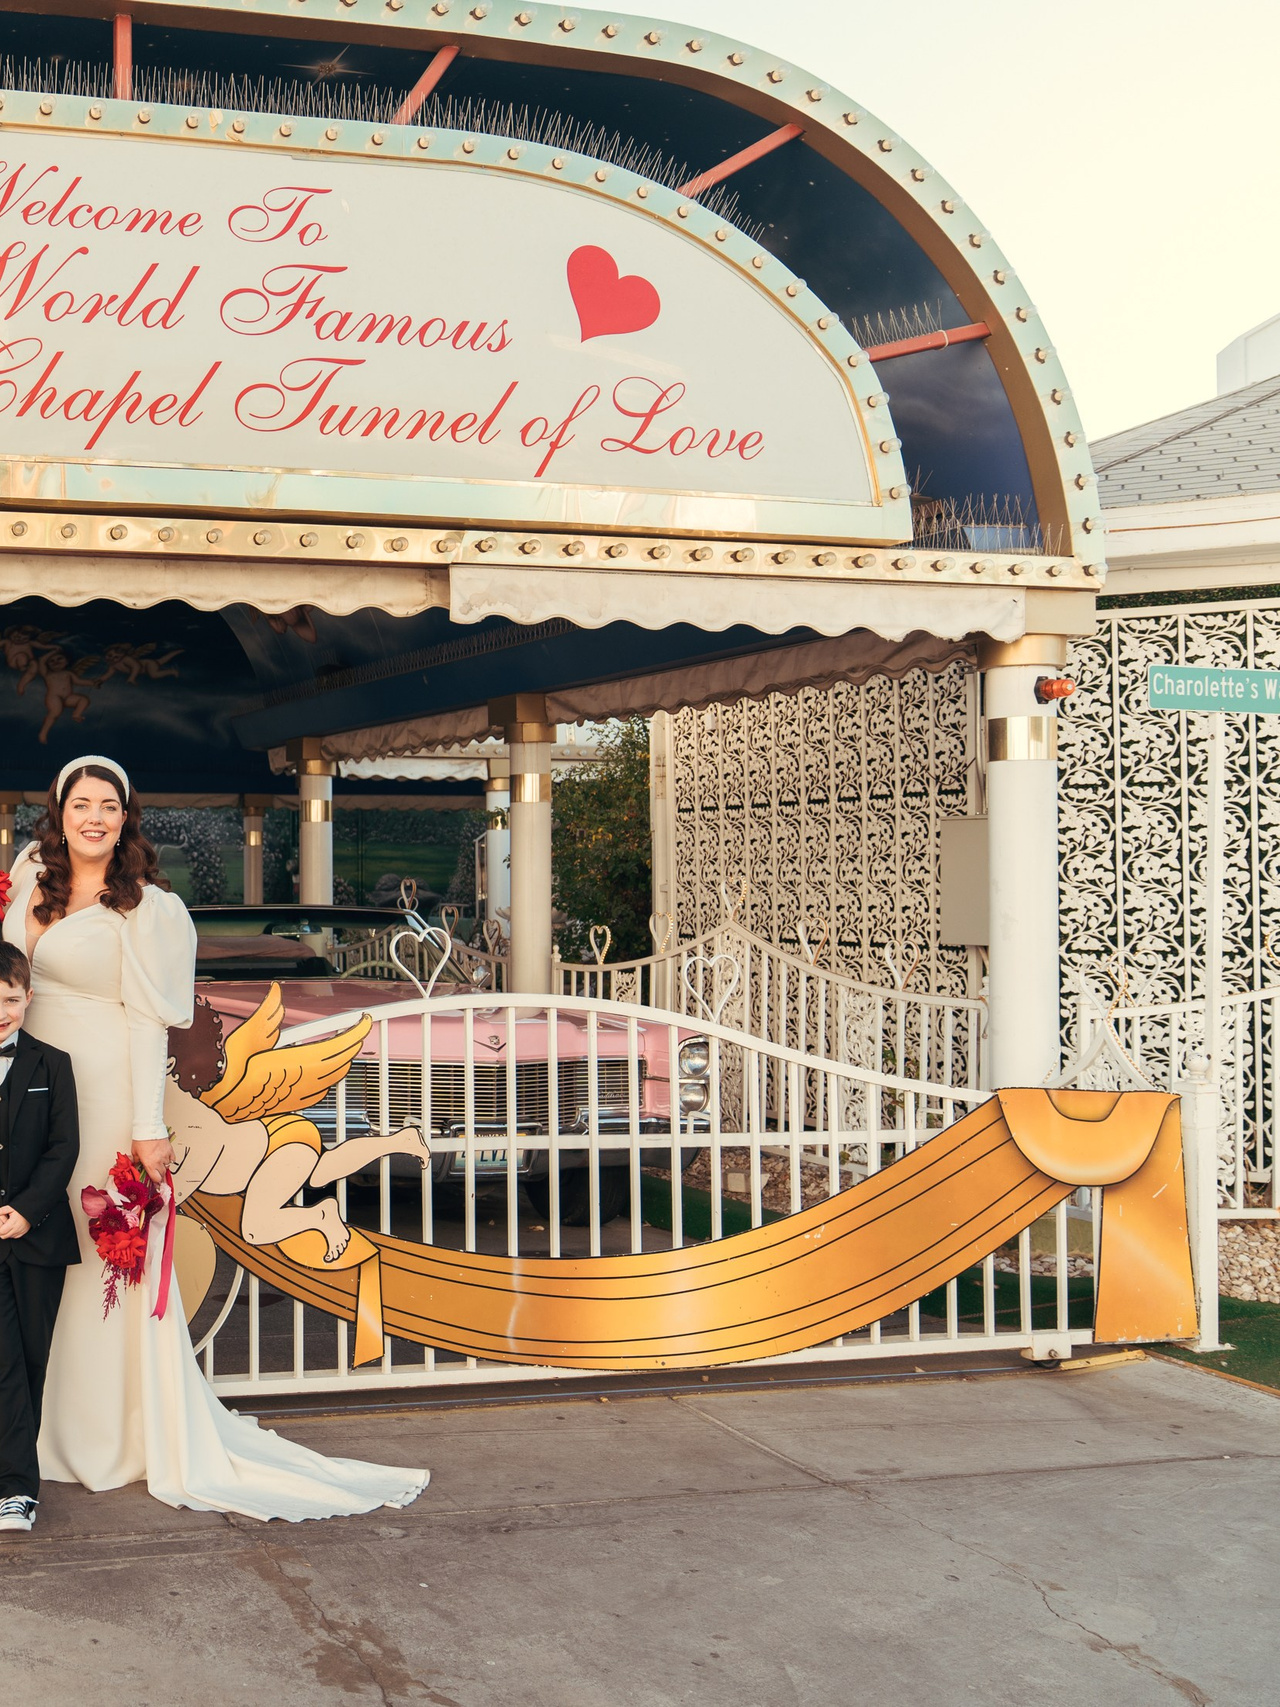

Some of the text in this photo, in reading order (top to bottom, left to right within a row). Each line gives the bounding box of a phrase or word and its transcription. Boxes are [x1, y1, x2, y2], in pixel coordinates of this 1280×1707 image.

[228, 187, 330, 247] To
[220, 264, 513, 352] Famous
[234, 357, 519, 446] Tunnel
[520, 385, 601, 478] of
[600, 377, 764, 461] Love
[1153, 673, 1280, 700] Charolette's W
